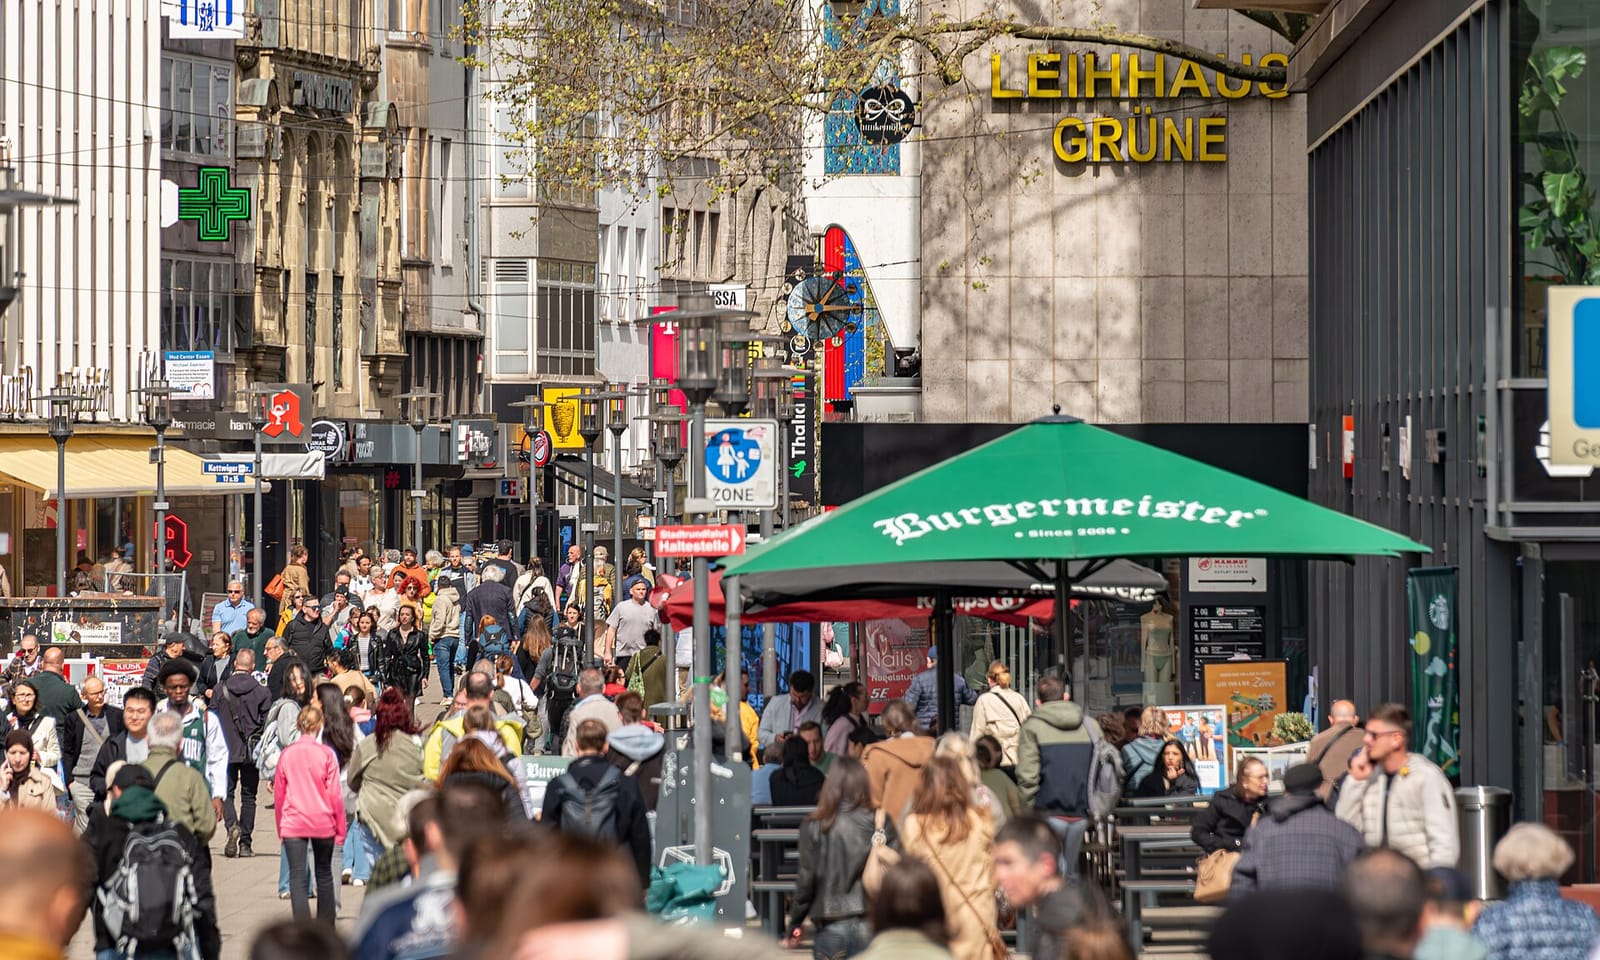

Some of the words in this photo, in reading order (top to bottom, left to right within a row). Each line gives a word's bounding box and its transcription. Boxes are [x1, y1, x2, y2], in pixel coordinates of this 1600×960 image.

[991, 53, 1289, 98] LEIHHAUS
[1053, 106, 1227, 162] GRÜNE
[791, 403, 806, 459] Thalia
[712, 487, 755, 502] ZONE
[660, 529, 729, 540] Stadtrundfahrt
[1028, 529, 1073, 538] Since
[1077, 527, 1116, 536] 2006
[658, 540, 730, 553] Haltestelle
[867, 650, 913, 668] Nails
